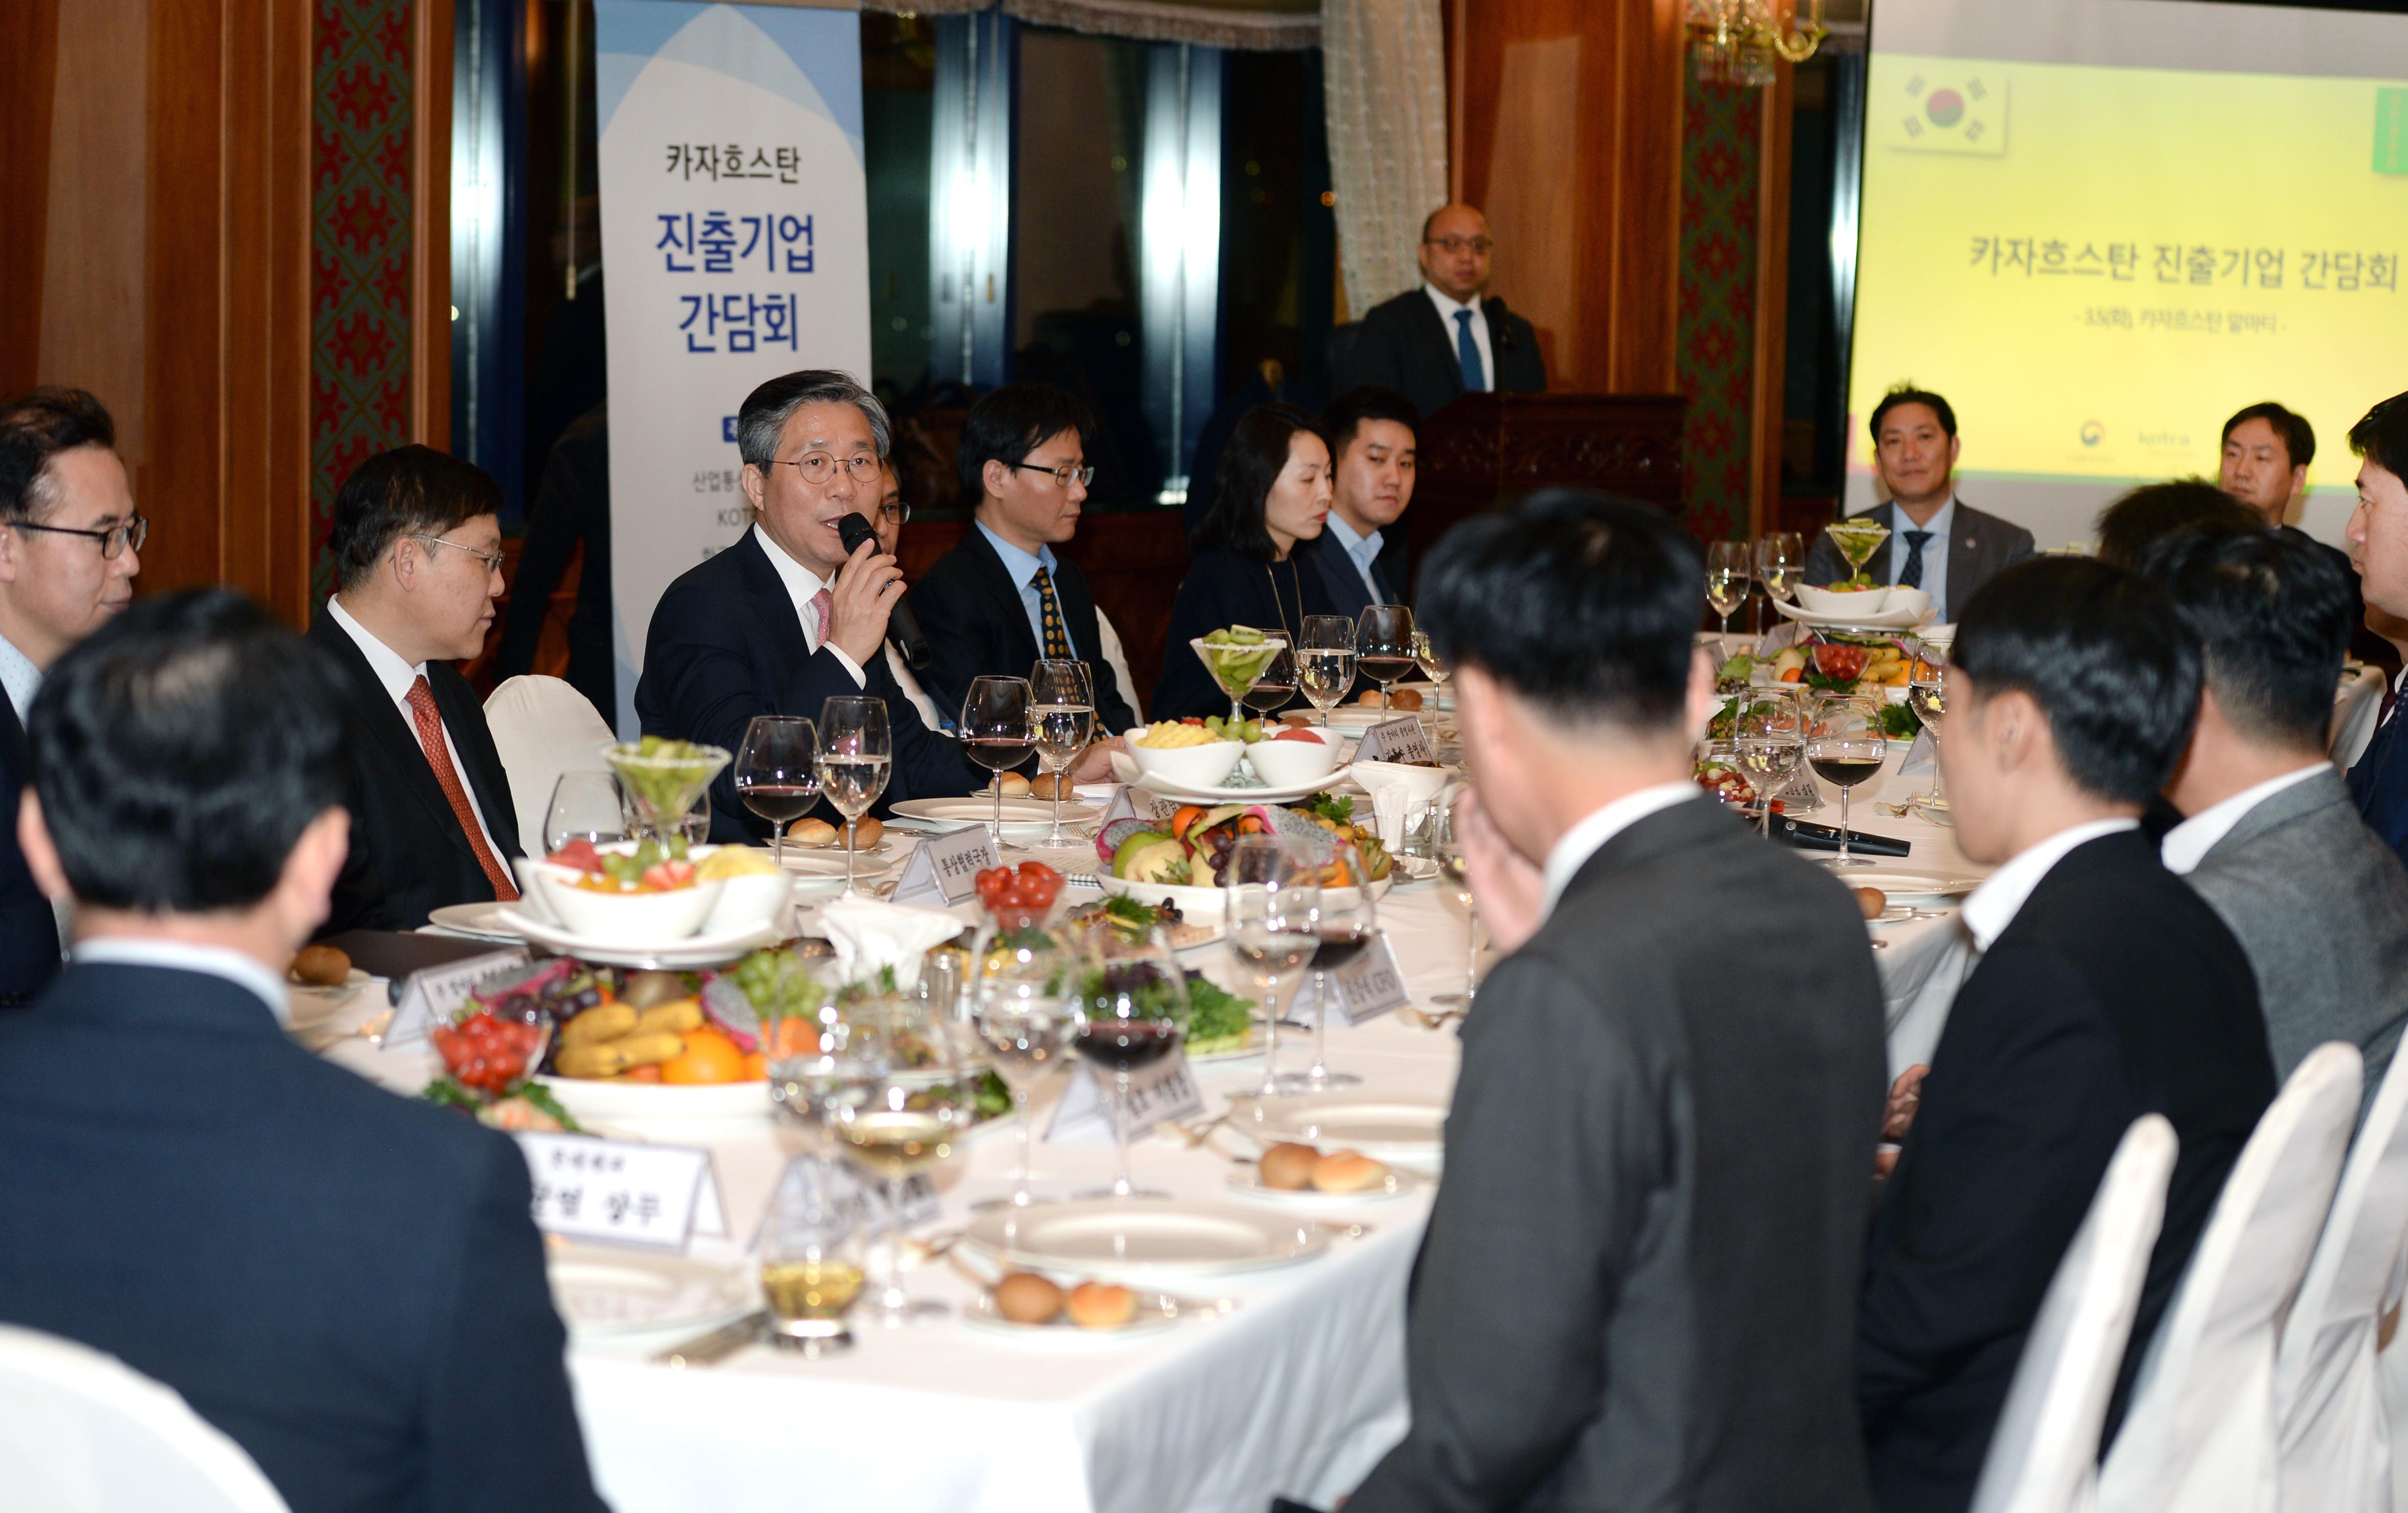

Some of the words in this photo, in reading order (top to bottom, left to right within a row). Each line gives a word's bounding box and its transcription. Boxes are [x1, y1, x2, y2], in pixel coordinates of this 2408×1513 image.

[667, 144, 800, 184] 카자흐스탄
[657, 211, 815, 274] 진출기업
[1970, 234, 2141, 281] 카자흐스탄
[2153, 243, 2286, 289] 진출기업
[2299, 250, 2399, 293] 간담회
[679, 293, 798, 353] 간담회
[2140, 308, 2222, 334] 카자흐스탄
[1400, 723, 1416, 738] 총영사관
[1407, 740, 1427, 760] 총영사
[941, 846, 991, 877] 통상협력국장
